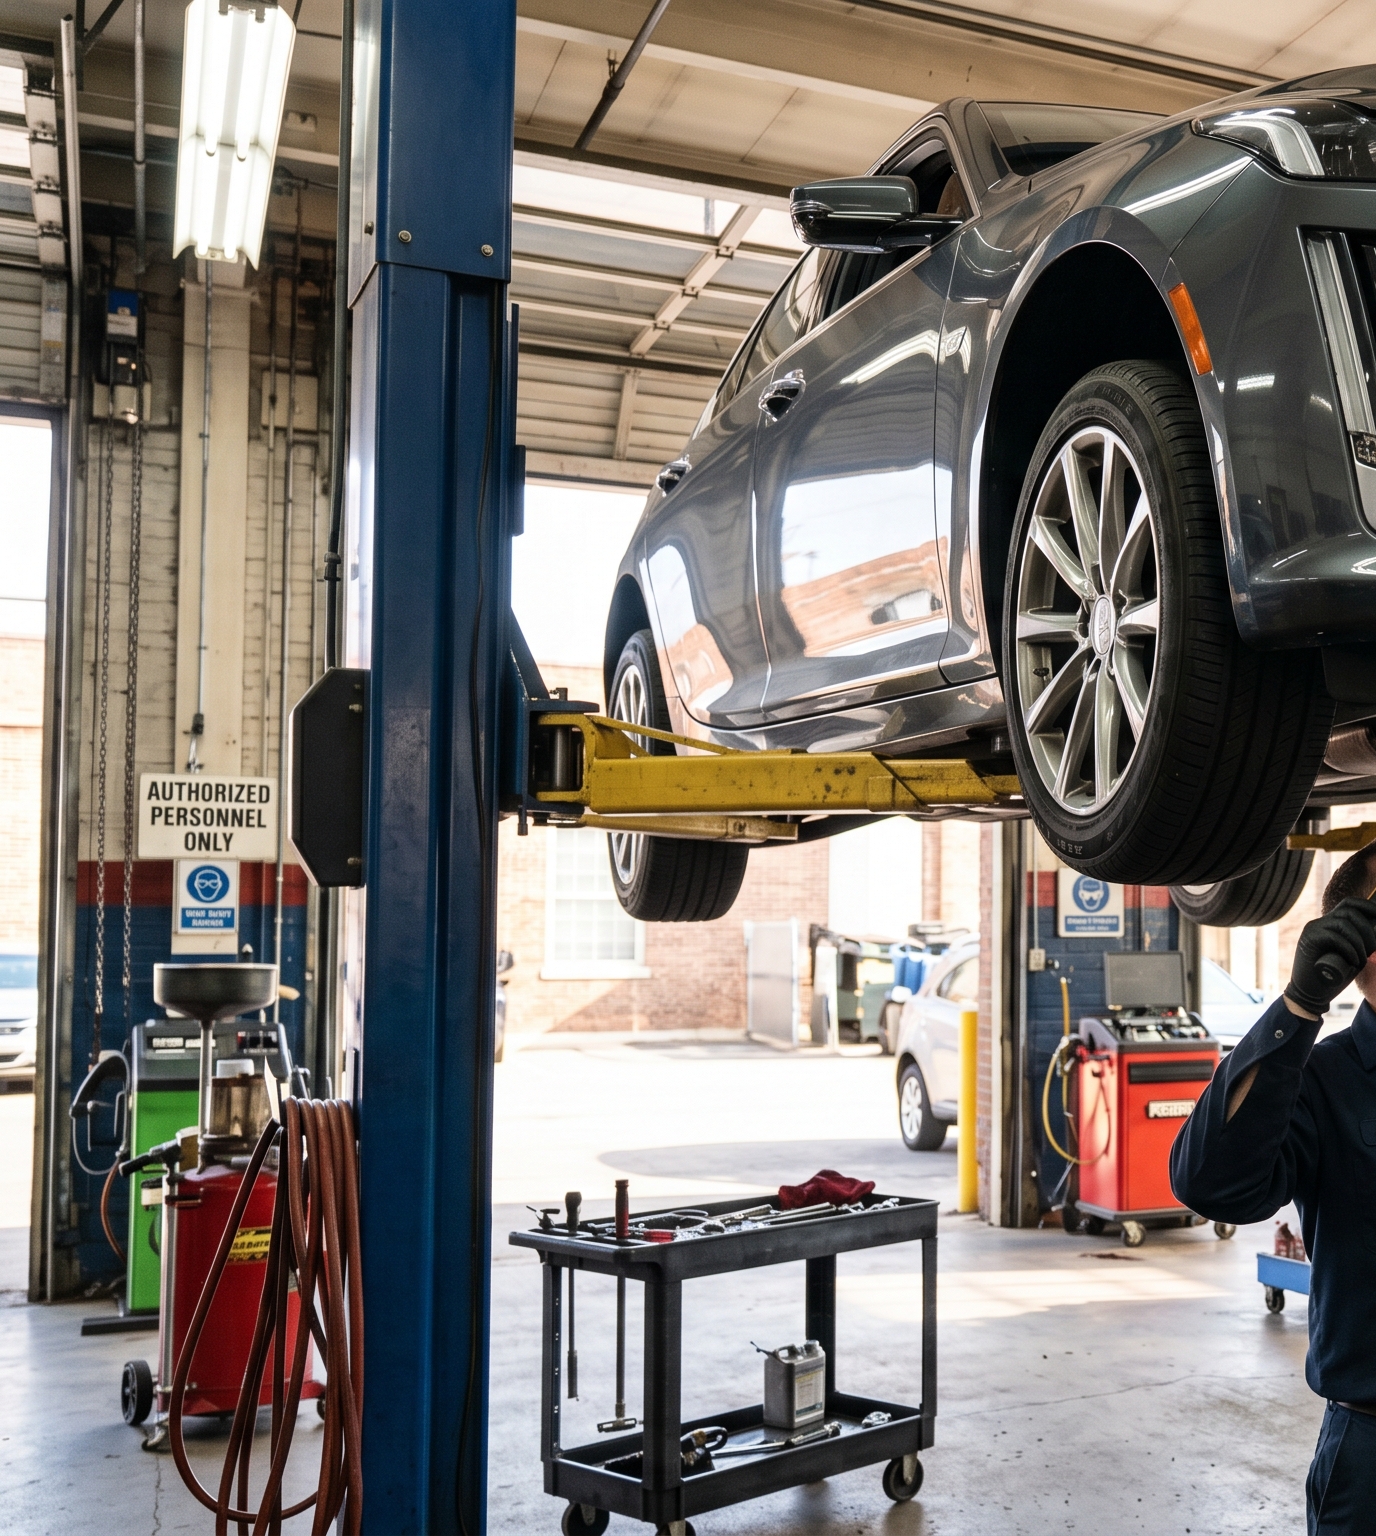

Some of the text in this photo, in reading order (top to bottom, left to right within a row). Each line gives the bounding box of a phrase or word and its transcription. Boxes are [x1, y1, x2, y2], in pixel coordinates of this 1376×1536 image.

[147, 781, 271, 804] AUTHORIZED
[150, 806, 267, 828] PERSONNEL
[184, 831, 234, 852] ONLY
